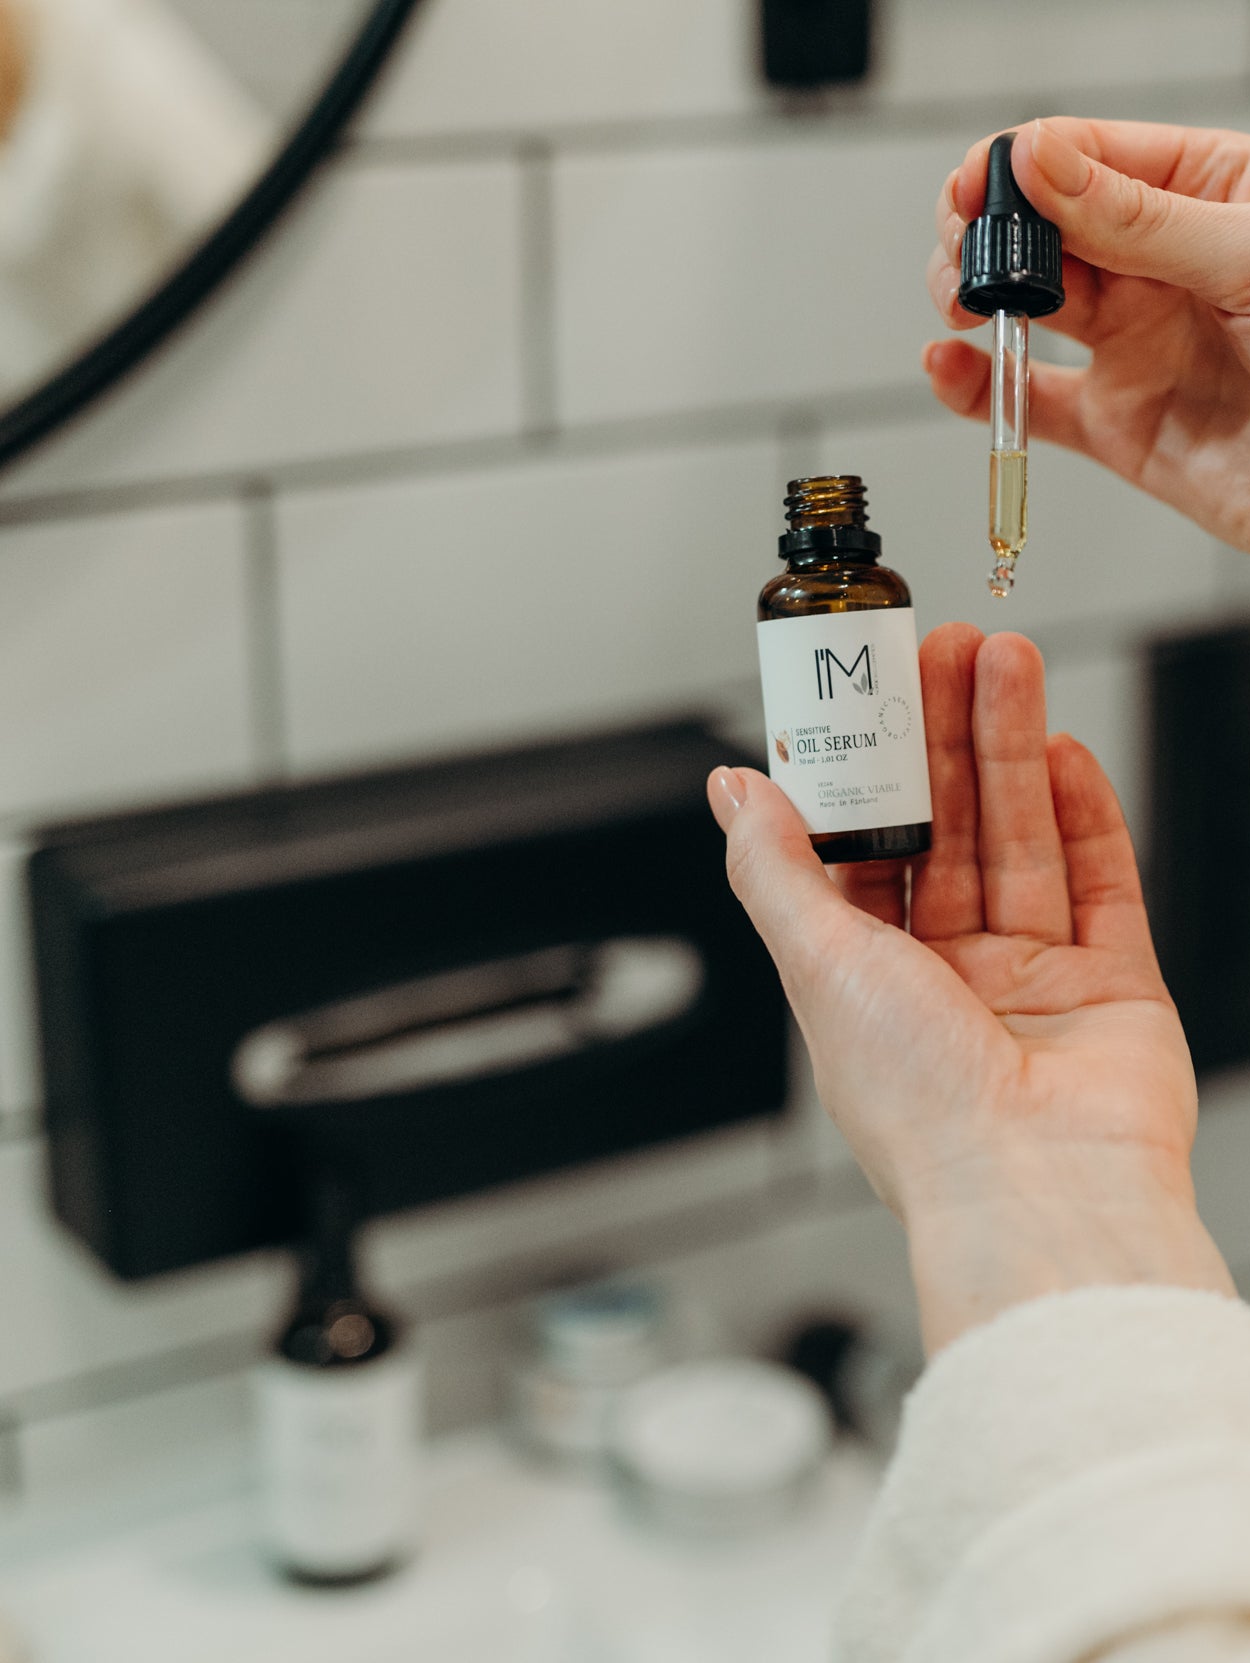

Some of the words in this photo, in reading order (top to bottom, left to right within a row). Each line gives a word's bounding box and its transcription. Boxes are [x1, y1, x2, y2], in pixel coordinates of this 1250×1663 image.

[796, 725, 831, 736] SENSITIVE
[797, 738, 821, 754] OIL
[824, 732, 878, 752] SERUM
[818, 786, 865, 799] ORGANIC
[868, 783, 902, 794] VIABLE
[839, 799, 847, 807] in
[850, 797, 878, 806] Finland
